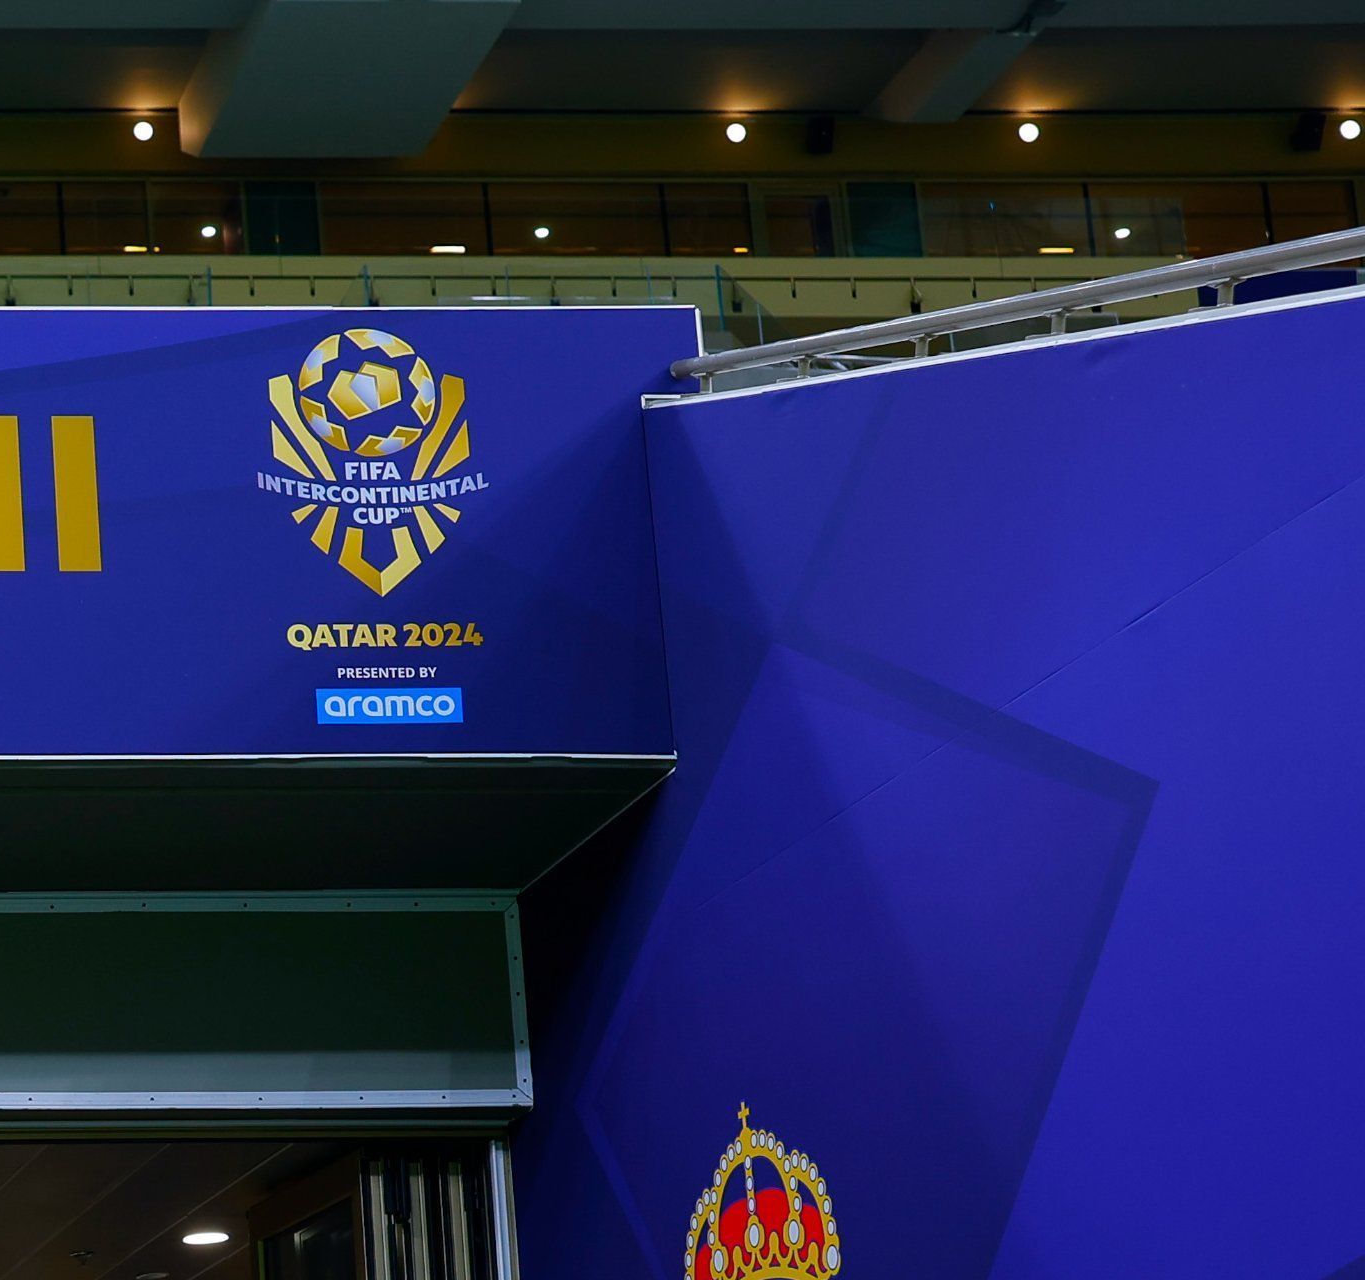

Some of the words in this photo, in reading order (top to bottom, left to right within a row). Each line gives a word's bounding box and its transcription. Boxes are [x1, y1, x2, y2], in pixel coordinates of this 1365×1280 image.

[344, 461, 401, 481] FIFA
[257, 472, 489, 504] INTERCONTINENTAL
[287, 624, 398, 651] QATAR
[403, 623, 484, 648] 2024
[337, 667, 416, 679] PRESENTED
[419, 667, 438, 678] BY
[324, 695, 456, 717] aramco
